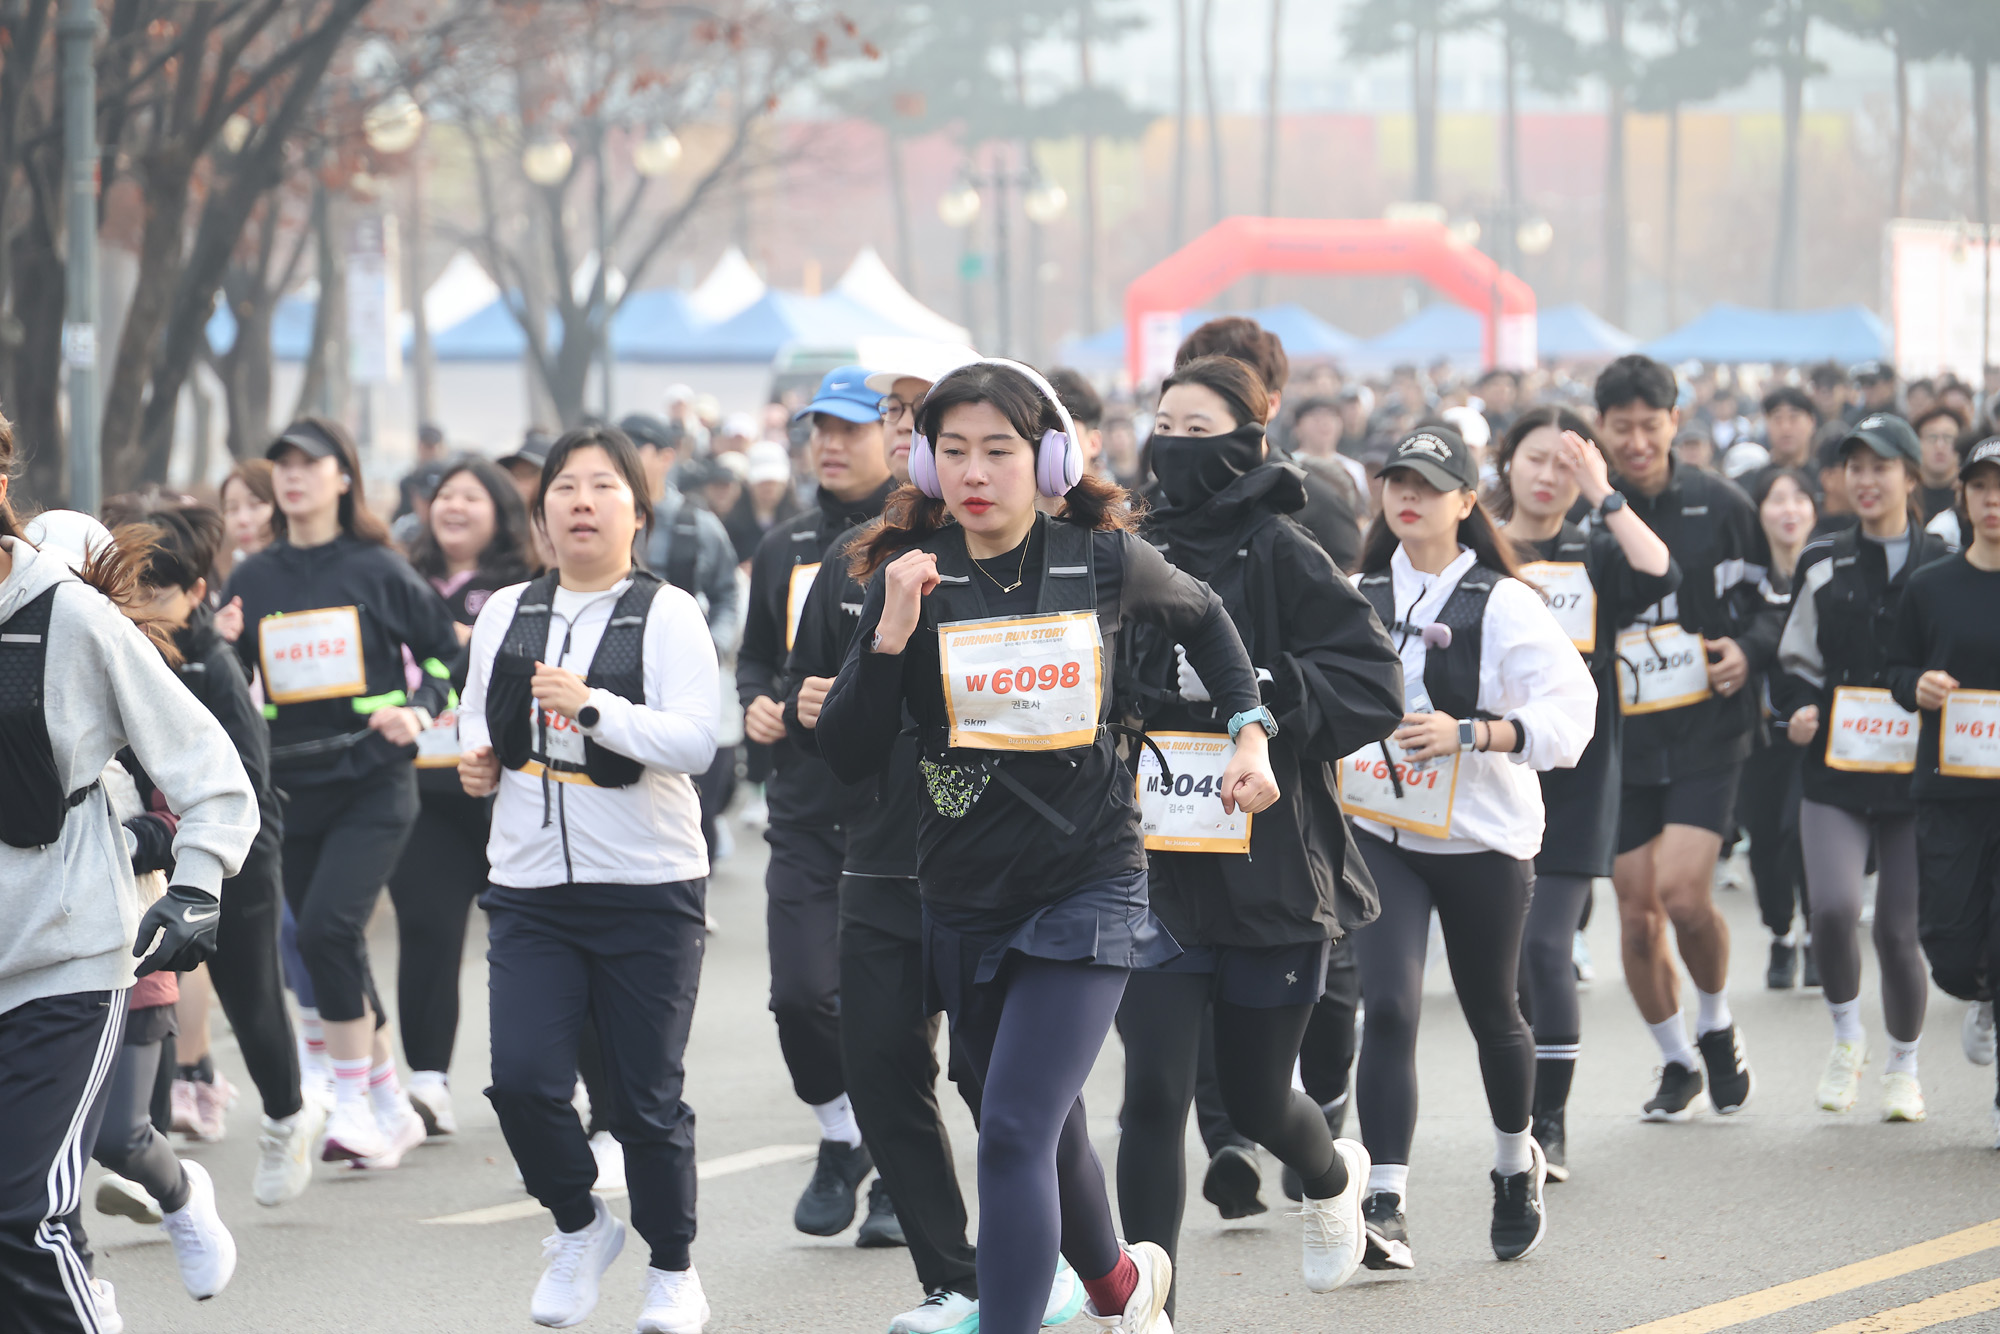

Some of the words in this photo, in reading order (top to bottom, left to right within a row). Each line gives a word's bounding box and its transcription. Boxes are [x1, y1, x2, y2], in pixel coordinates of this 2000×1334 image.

[952, 633, 1003, 647] BURNING
[1004, 630, 1029, 642] RUN
[1030, 627, 1067, 640] STORY
[965, 661, 1080, 694] W6098
[1011, 700, 1041, 710] 권로사
[963, 718, 987, 727] 5km
[1955, 721, 2000, 738] W61
[1171, 742, 1192, 751] RUN
[1193, 743, 1228, 752] STORY
[1169, 803, 1194, 814] 김수연
